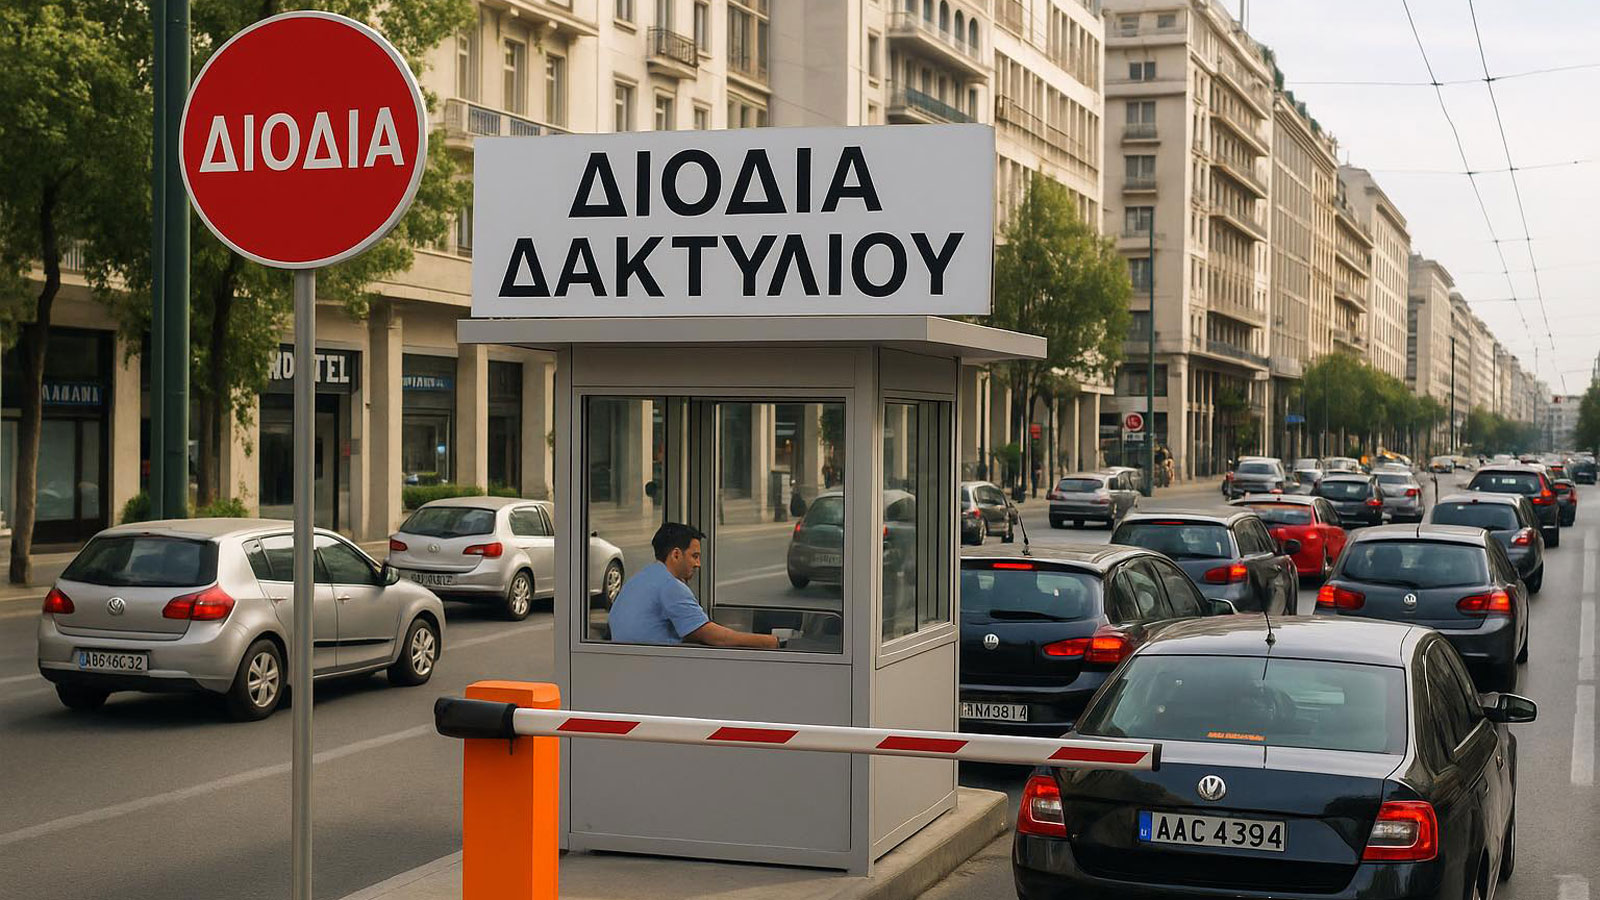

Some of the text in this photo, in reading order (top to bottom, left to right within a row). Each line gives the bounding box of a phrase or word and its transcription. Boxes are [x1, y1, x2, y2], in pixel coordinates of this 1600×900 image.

[199, 106, 405, 173] ΔΙΟΔΙΑ
[568, 146, 883, 218] ΔΙΟΔΙΑ
[498, 232, 965, 298] ΔΑΚΤΥΛΙΟΥ
[1156, 816, 1206, 842] AAC
[1213, 821, 1282, 849] 4394
